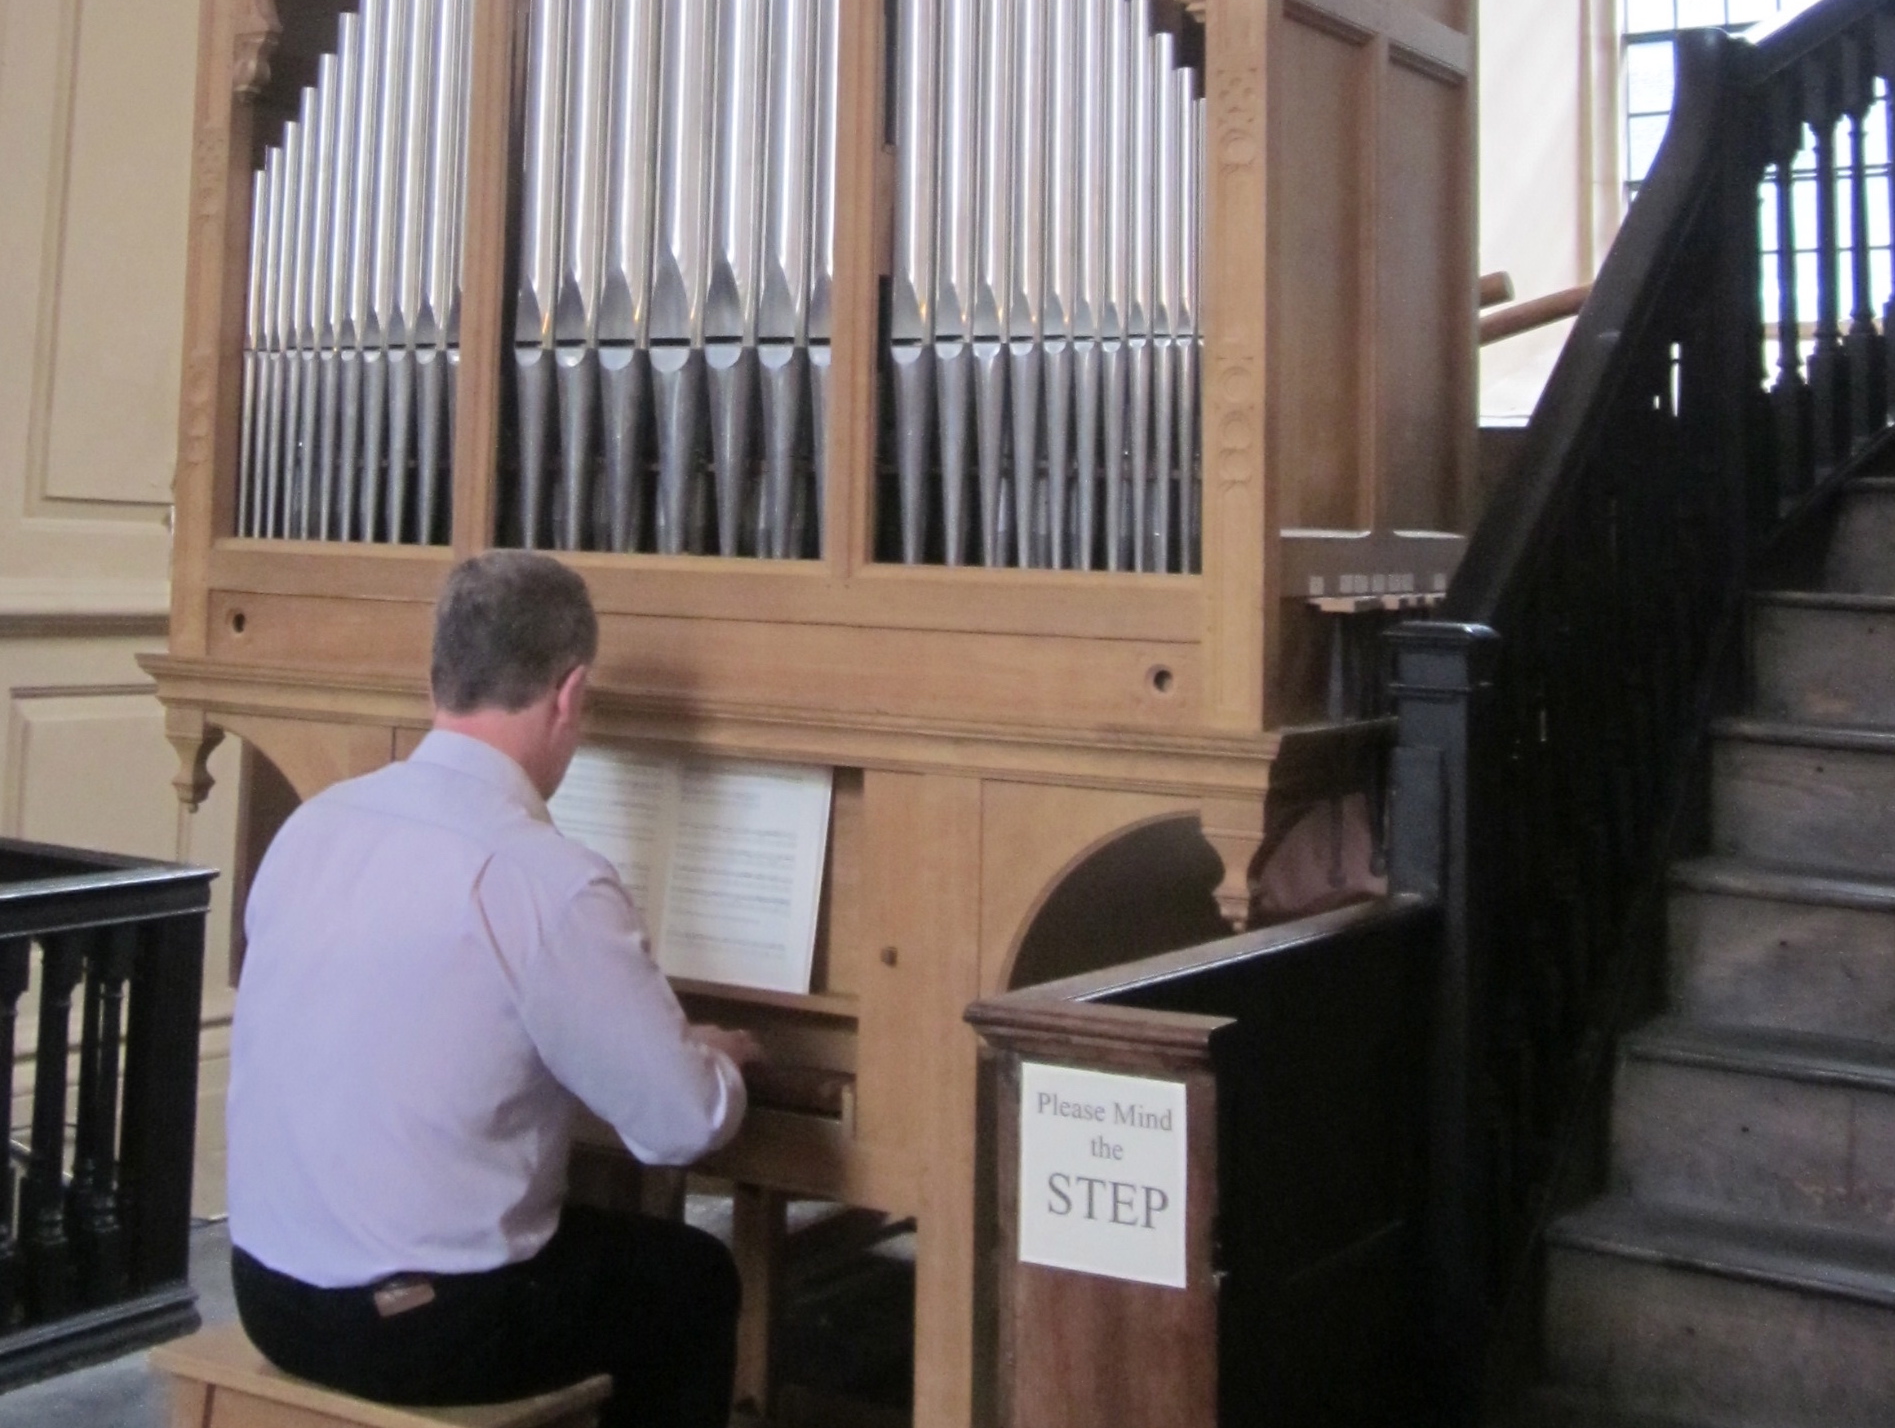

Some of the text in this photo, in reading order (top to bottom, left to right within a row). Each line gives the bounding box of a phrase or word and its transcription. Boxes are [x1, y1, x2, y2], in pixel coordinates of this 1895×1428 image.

[1037, 1092, 1173, 1131] Please Mind
[1091, 1135, 1123, 1160] the
[1048, 1172, 1169, 1229] STEP
